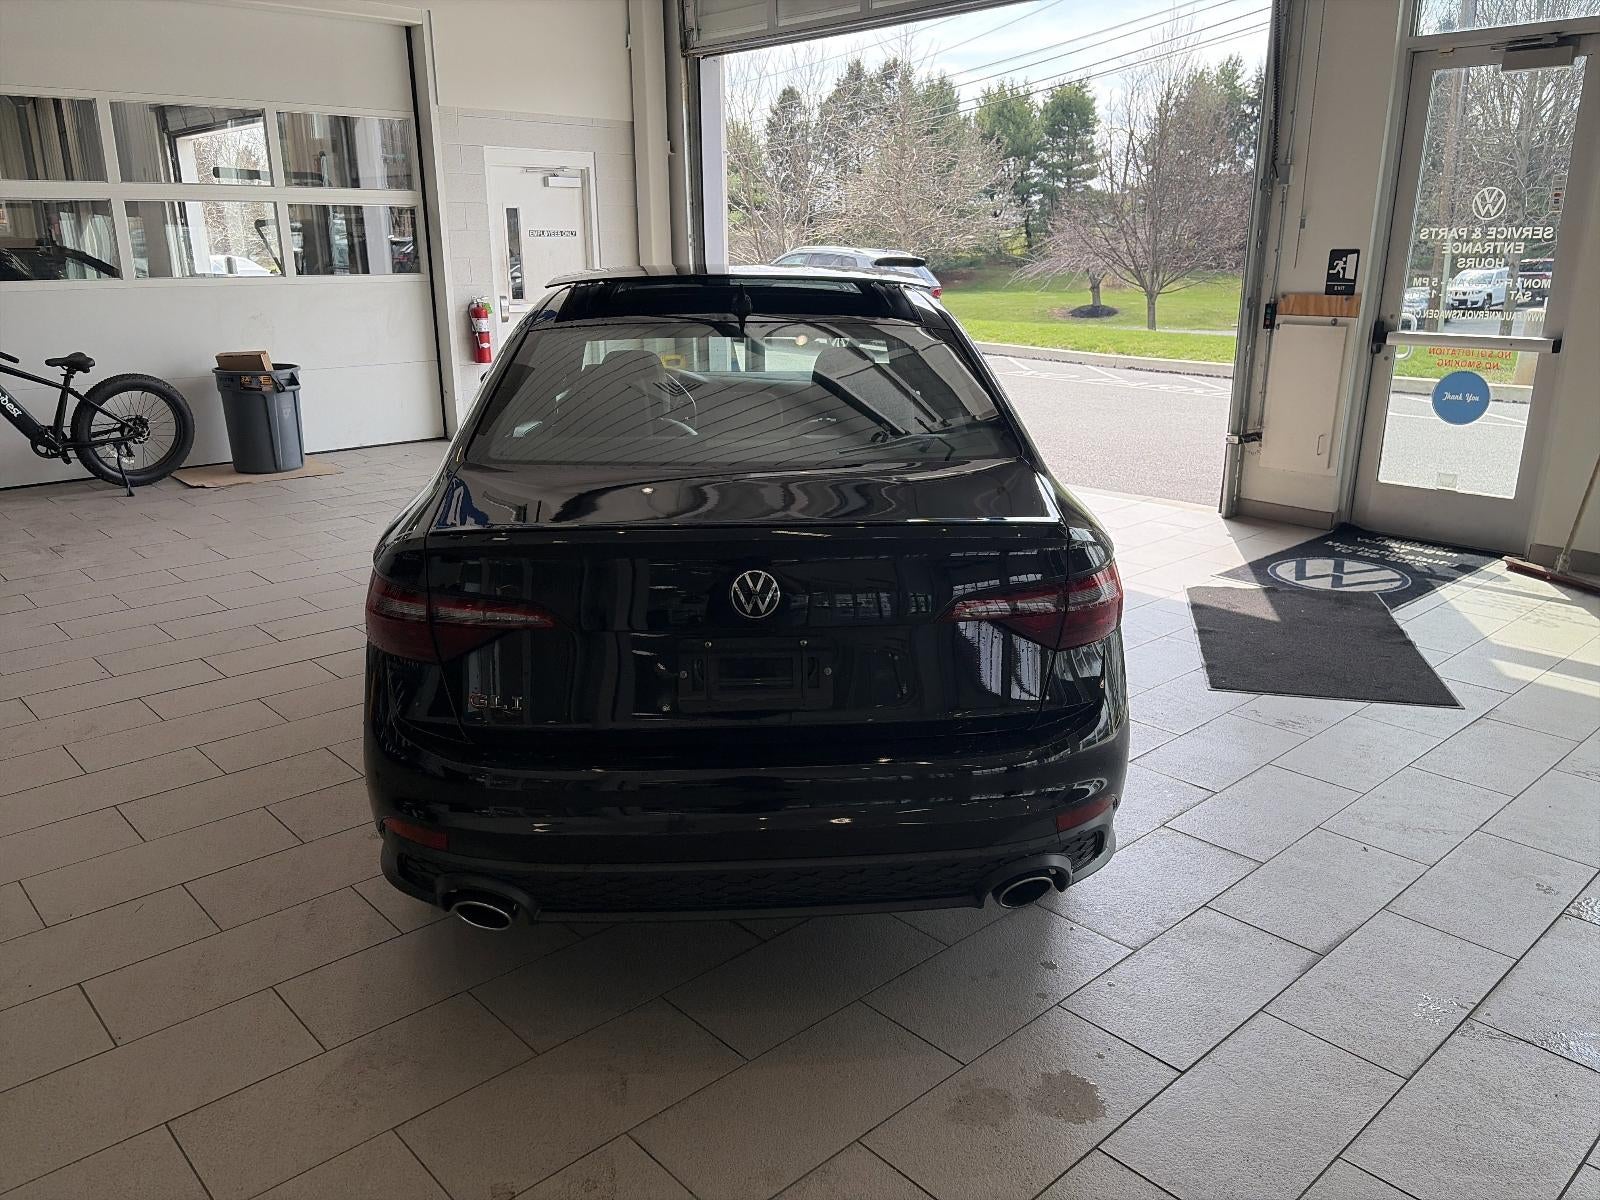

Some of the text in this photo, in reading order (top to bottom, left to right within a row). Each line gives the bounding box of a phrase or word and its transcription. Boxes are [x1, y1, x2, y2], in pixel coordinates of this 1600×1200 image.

[1442, 391, 1480, 403] Thank You
[470, 693, 523, 711] GLI
